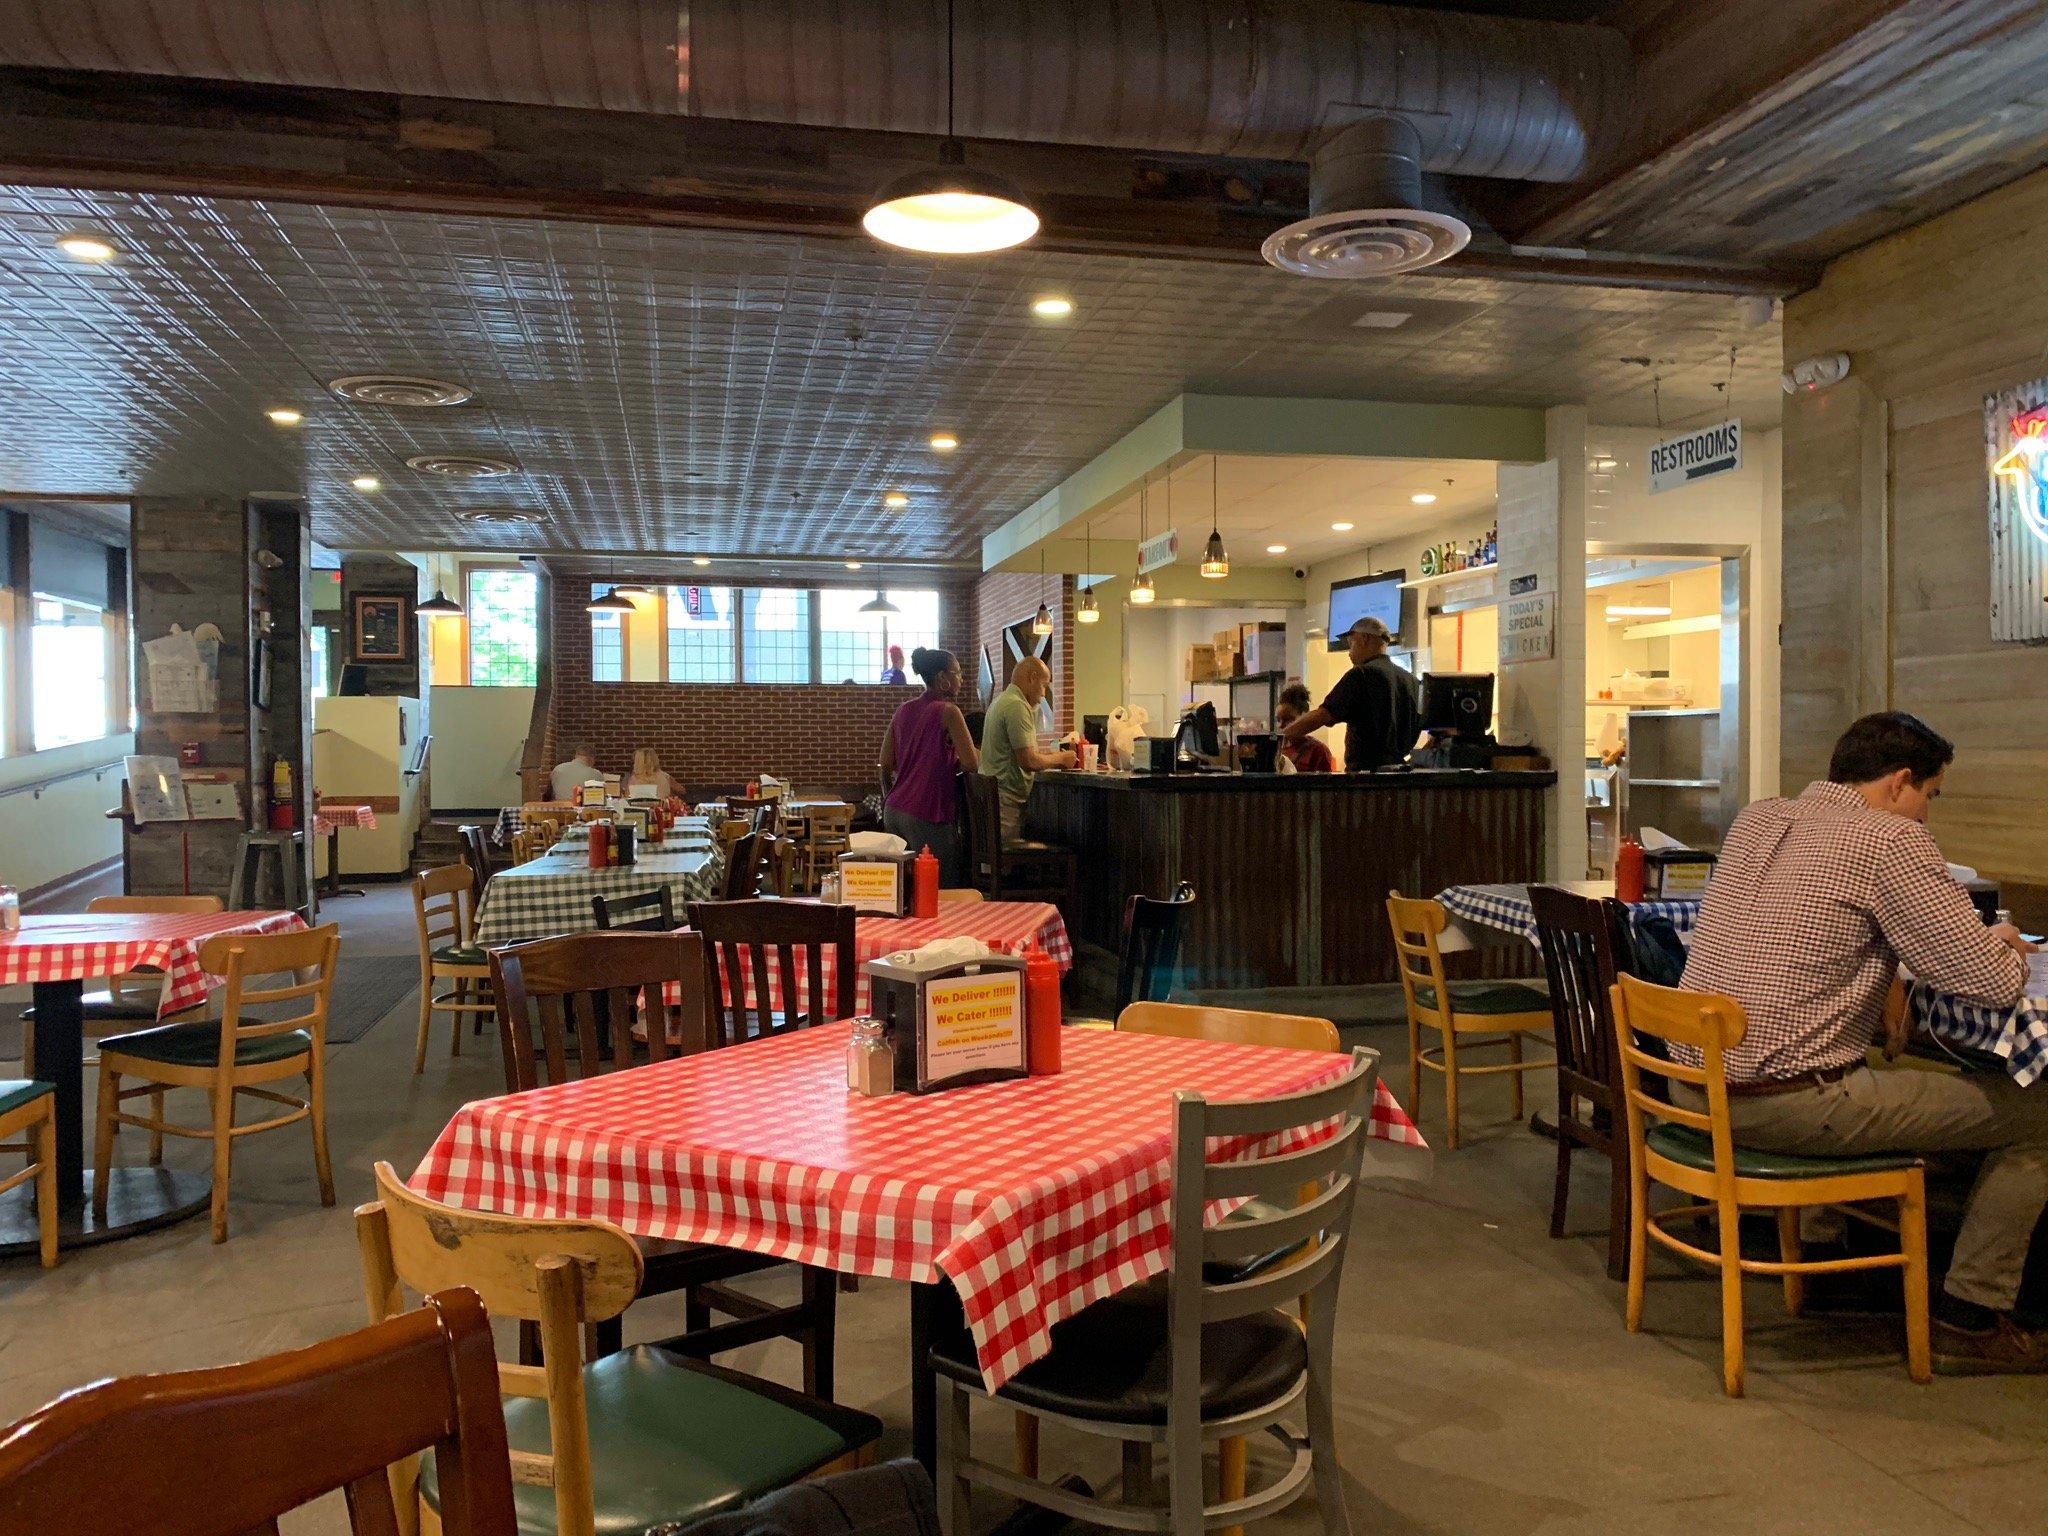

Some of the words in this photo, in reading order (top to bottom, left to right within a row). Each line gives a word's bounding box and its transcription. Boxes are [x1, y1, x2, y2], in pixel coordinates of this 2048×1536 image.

[1651, 424, 1738, 475] RESTROOMS
[1508, 599, 1544, 616] TODAY'S
[1508, 615, 1544, 631] SPECIAL
[932, 995, 949, 1005] We
[953, 991, 991, 1003] Deliver
[937, 1014, 953, 1025] We
[957, 1011, 986, 1022] Cater
